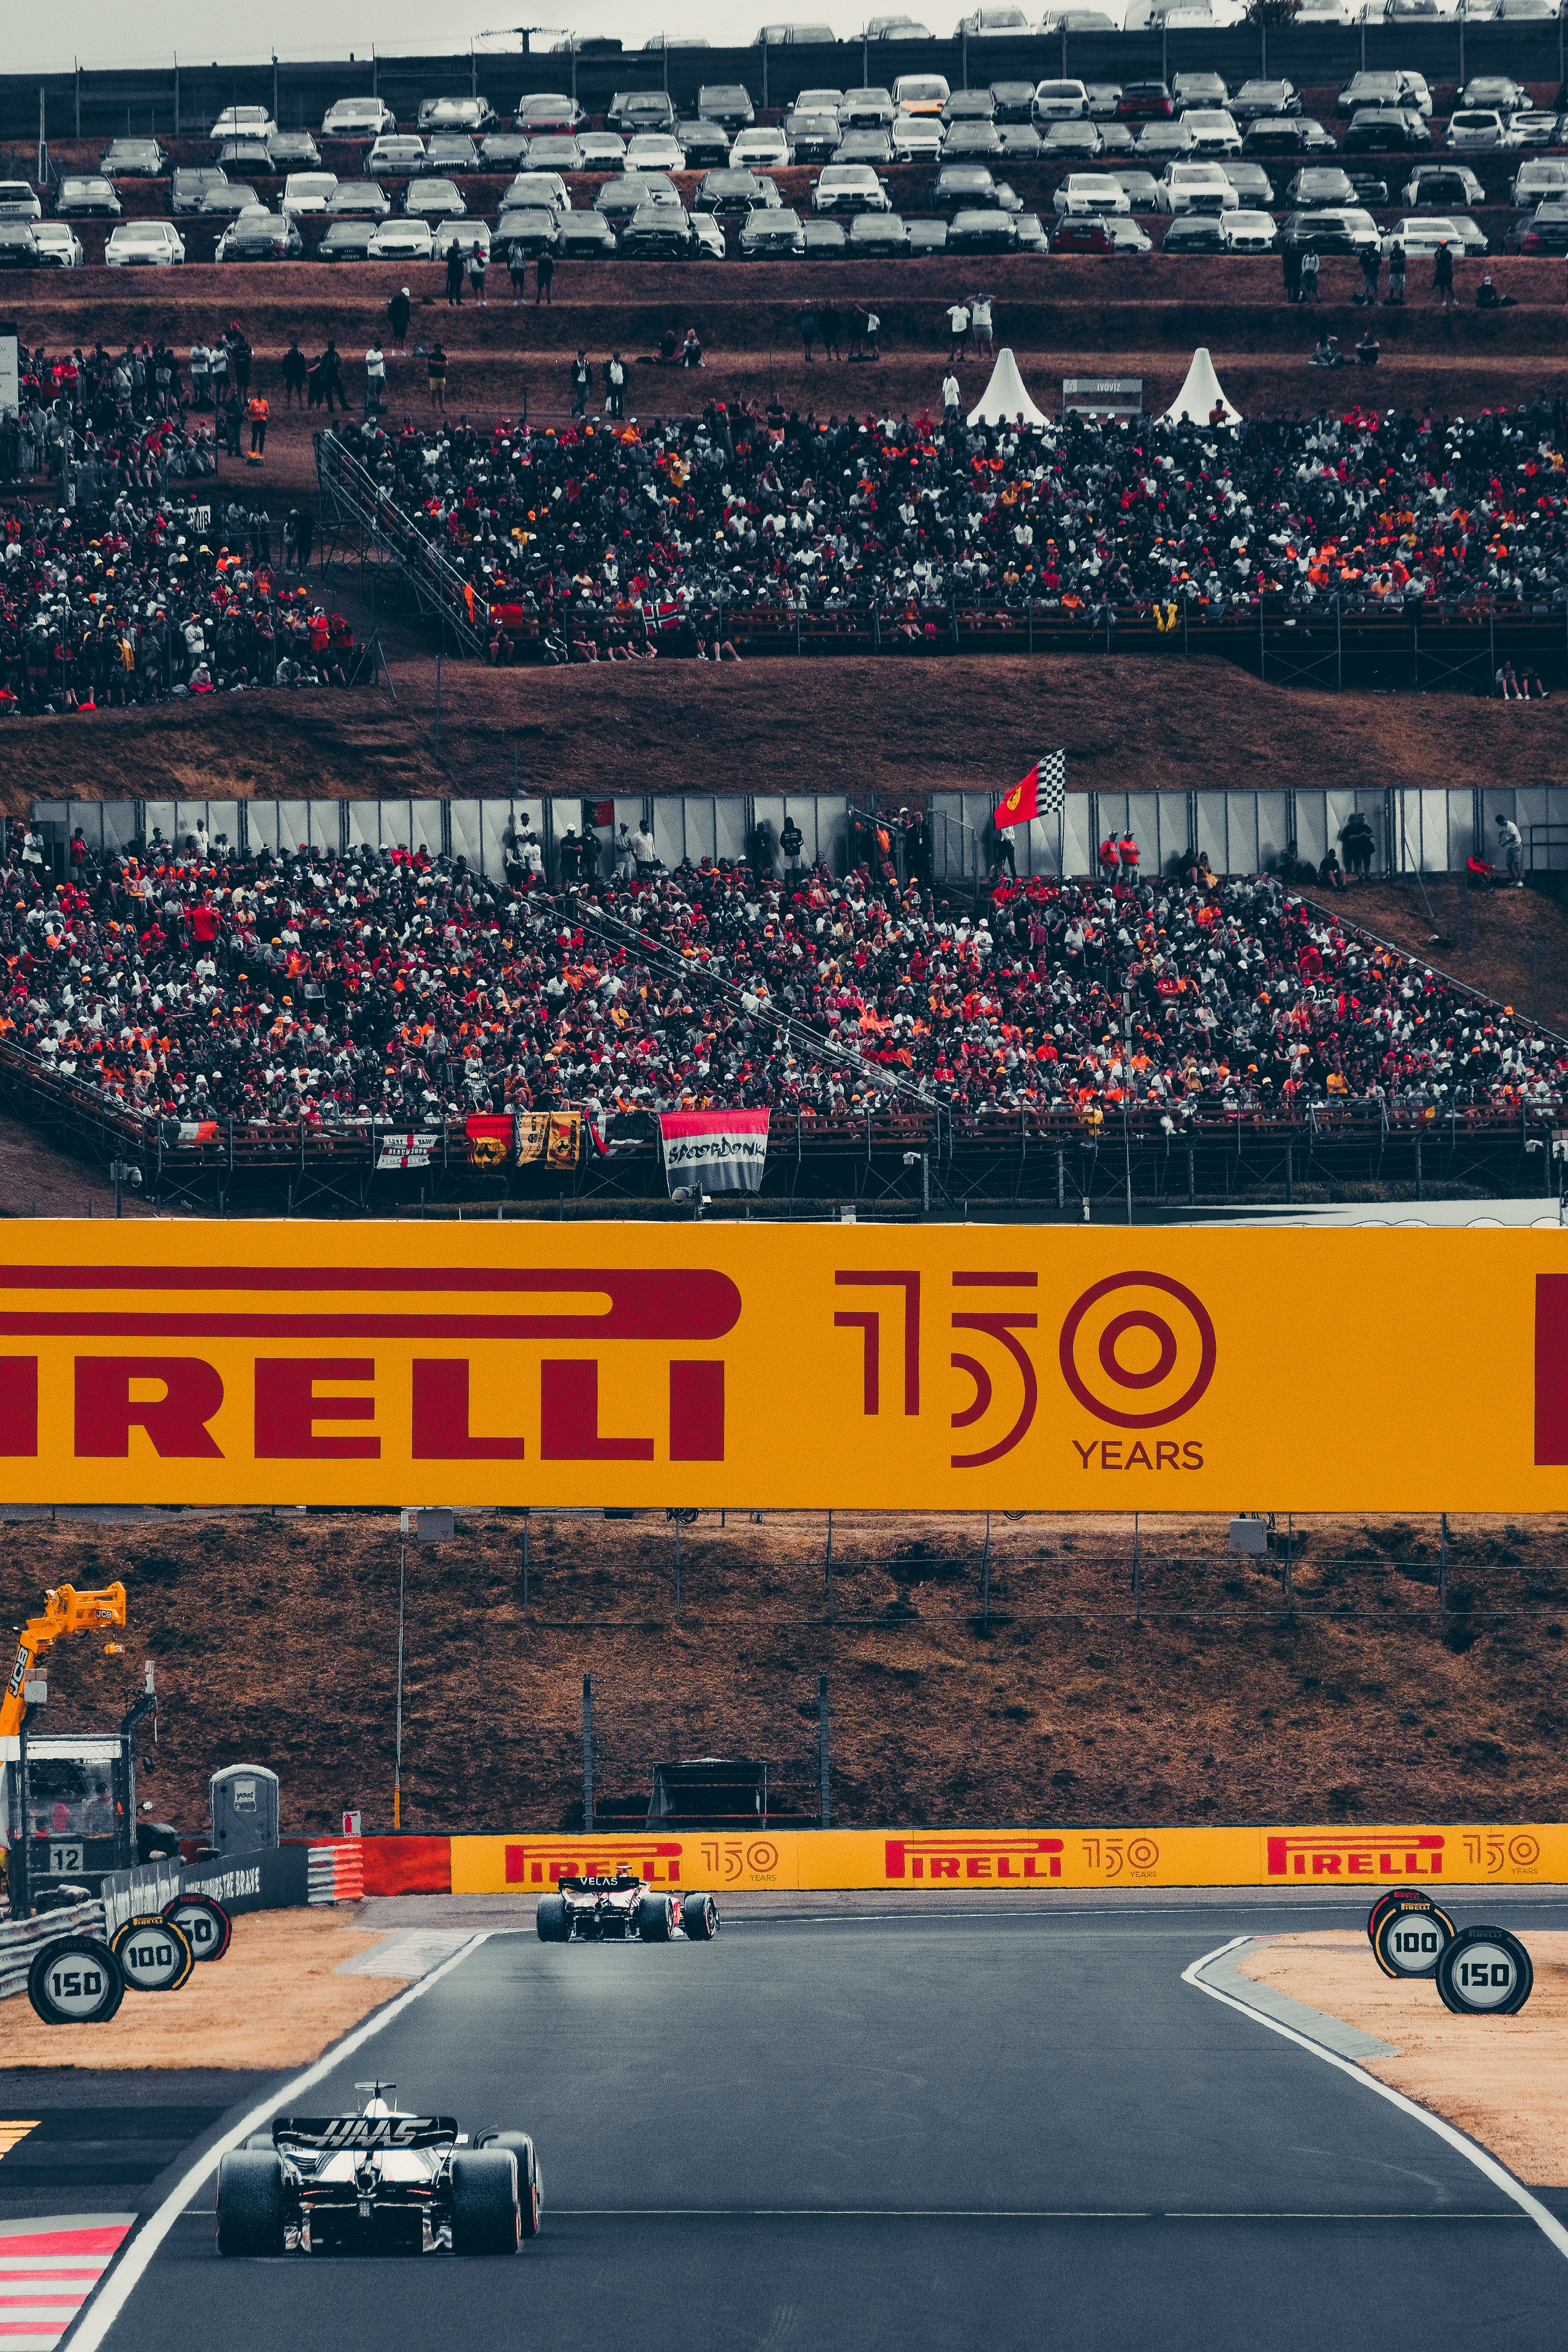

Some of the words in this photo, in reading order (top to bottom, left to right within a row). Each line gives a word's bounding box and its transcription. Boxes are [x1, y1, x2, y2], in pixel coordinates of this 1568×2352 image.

[1097, 381, 1121, 392] IVÓVÍZ
[834, 1270, 1216, 1468] 150
[1071, 1440, 1204, 1471] YEARS
[97, 1610, 112, 1619] JCB
[10, 1646, 29, 1697] JCB
[53, 1850, 80, 1871] 12
[701, 1841, 778, 1882] 150
[885, 1838, 1065, 1879] PIRELLI
[1082, 1838, 1159, 1878] 150
[1267, 1835, 1445, 1875] PIRELLI
[1463, 1834, 1540, 1874] 150
[580, 1877, 618, 1886] VELAS
[1394, 1932, 1438, 1953] 100
[128, 1945, 173, 1968] 100
[52, 1972, 102, 1997] 150
[1460, 1963, 1510, 1987] 150
[298, 2119, 433, 2147] HAAS
